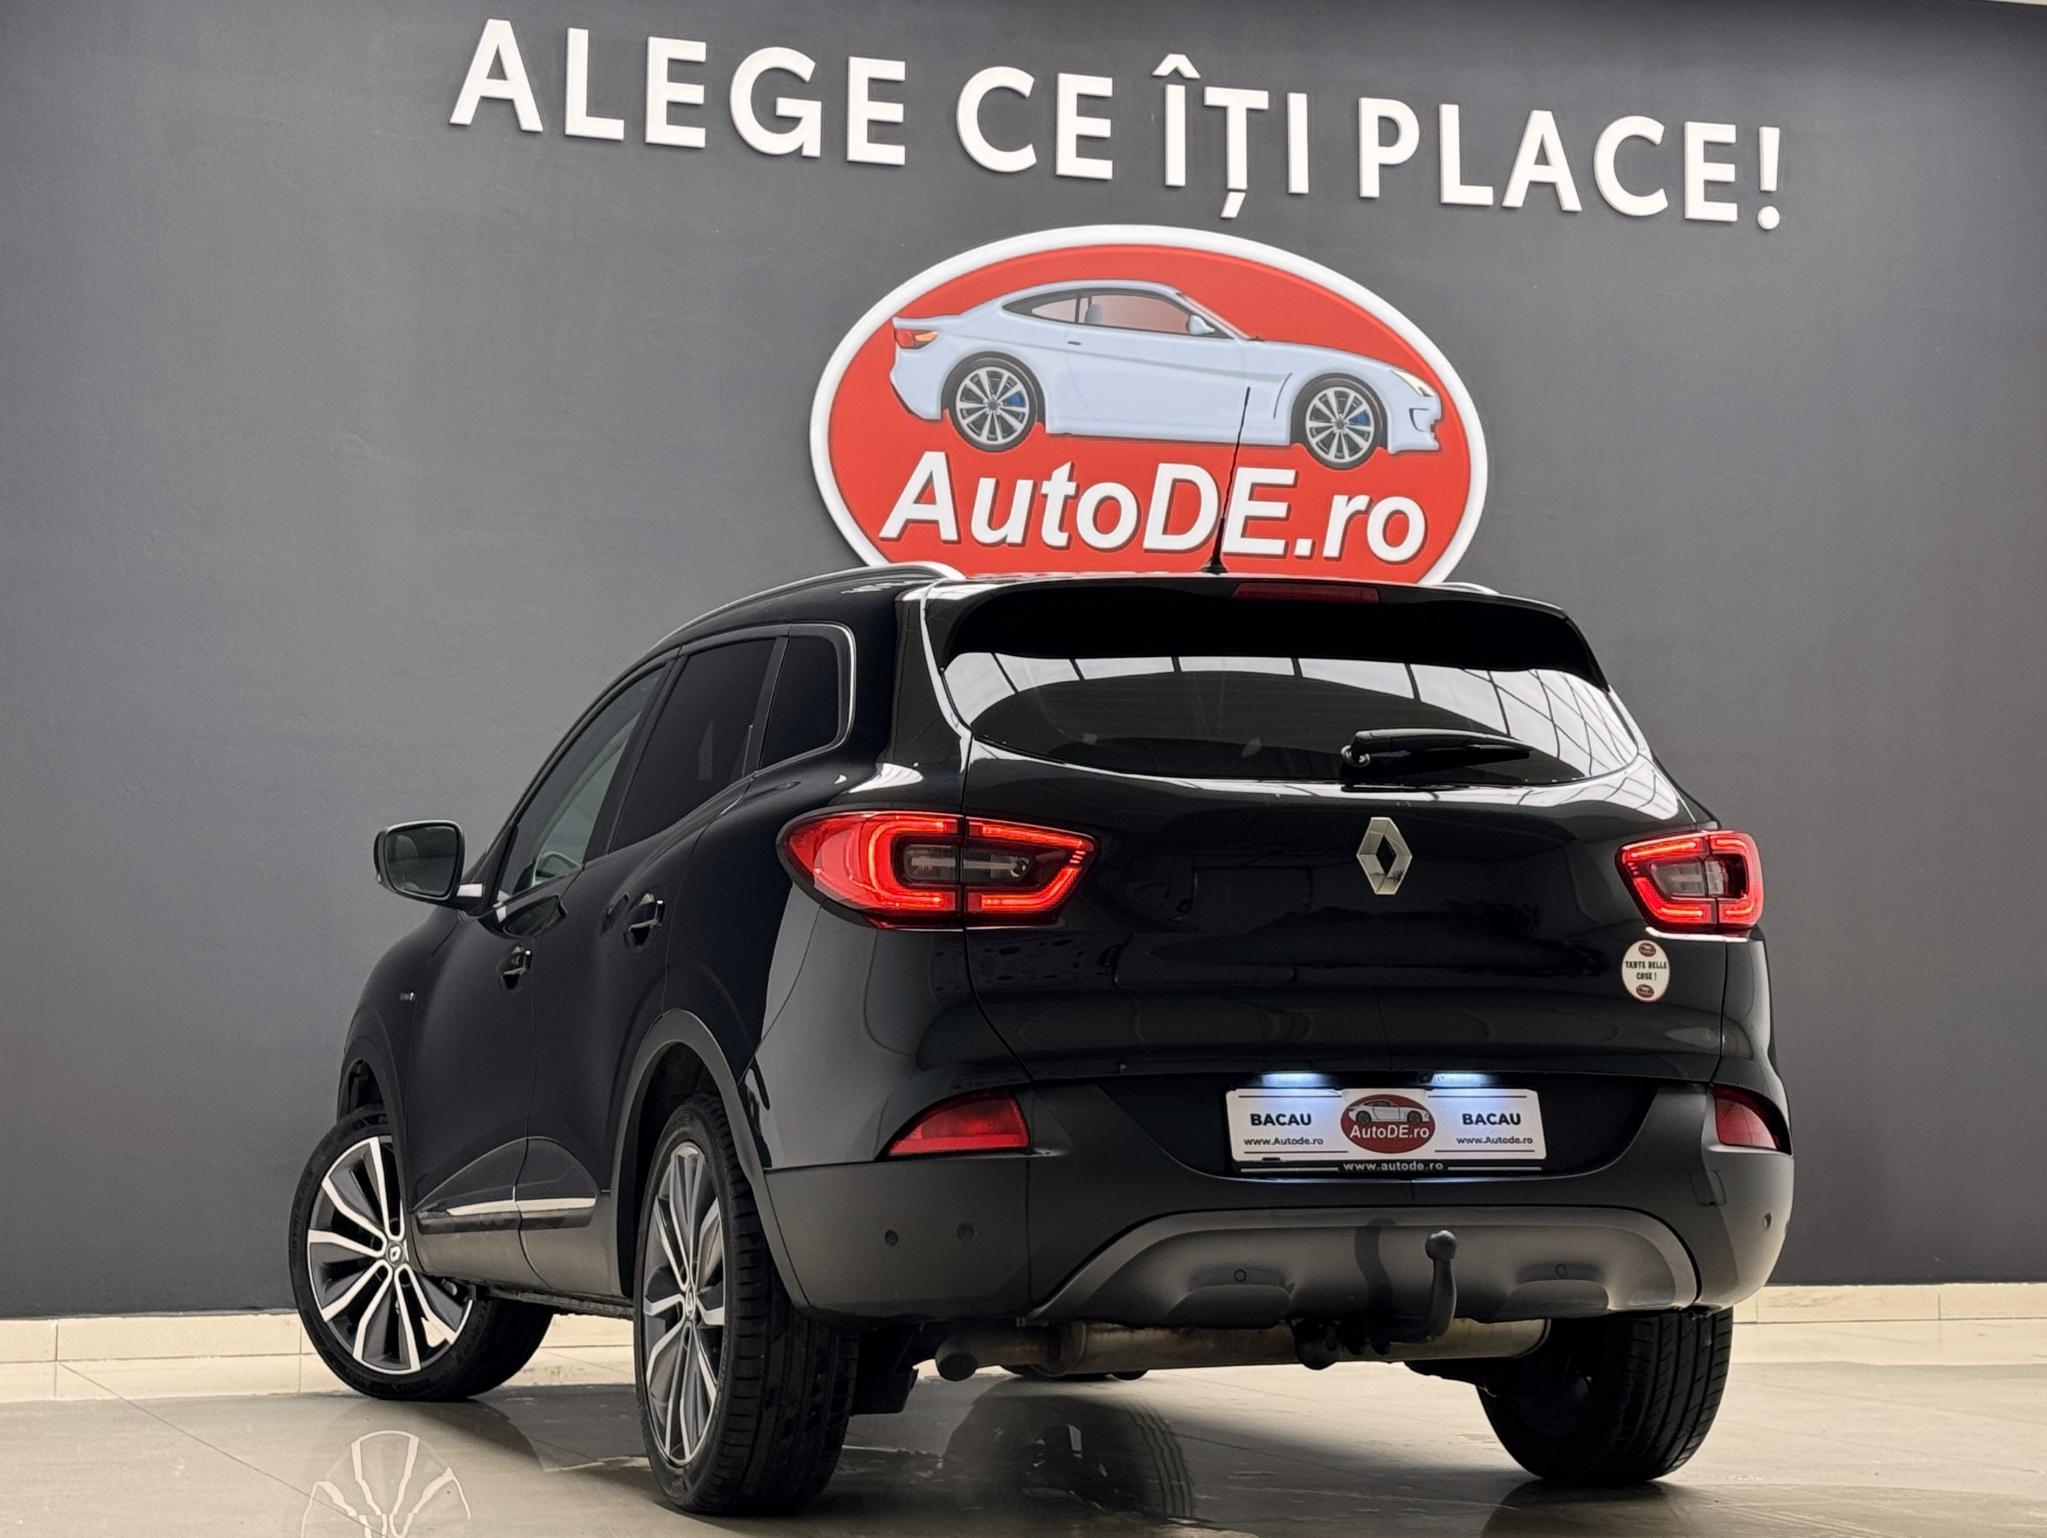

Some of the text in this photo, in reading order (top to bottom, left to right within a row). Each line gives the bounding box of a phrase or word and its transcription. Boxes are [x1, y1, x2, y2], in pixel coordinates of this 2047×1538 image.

[449, 18, 906, 166] ALEGE
[956, 65, 1115, 180] CE
[1359, 96, 1781, 230] PLACE!
[879, 450, 1427, 566] AutoDE.ro
[1250, 1113, 1312, 1126] BACAU
[1462, 1113, 1521, 1125] BACAU
[1349, 1124, 1430, 1139] AutoDE.ro
[1243, 1136, 1324, 1146] www.Autode.ro
[1456, 1135, 1534, 1145] www.Autode.ro
[1343, 1160, 1444, 1172] www.autode.ro
